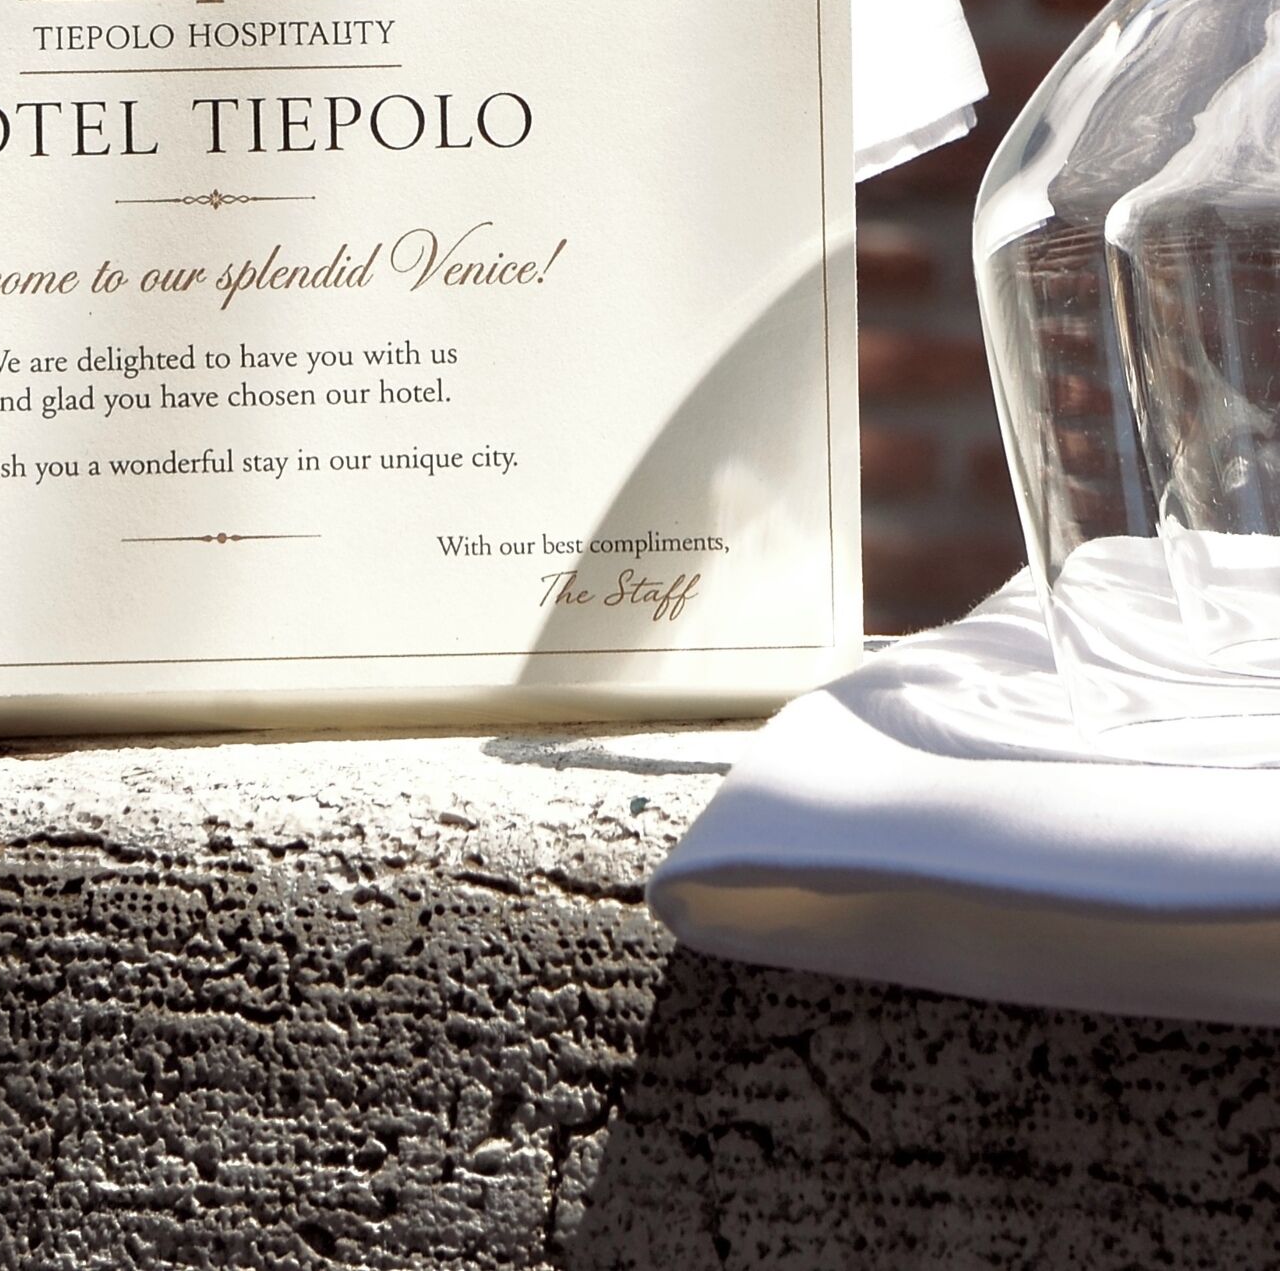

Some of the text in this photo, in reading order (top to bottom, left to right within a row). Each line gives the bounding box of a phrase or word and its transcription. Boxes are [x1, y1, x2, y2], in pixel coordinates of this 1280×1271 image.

[32, 19, 396, 51] TIEPOLO HOSPITALITY
[191, 91, 533, 155] TIEPOLO
[90, 259, 129, 294] to
[139, 267, 208, 293] our
[215, 243, 379, 310] splendid
[390, 220, 568, 292] Venice!
[29, 356, 69, 374] are
[76, 343, 197, 380] delighted
[204, 350, 232, 370] to
[239, 342, 298, 369] have
[305, 350, 354, 376] you
[362, 339, 422, 366] with
[430, 347, 458, 365] us
[41, 383, 96, 420] glad
[103, 392, 152, 419] you
[159, 382, 220, 409] have
[227, 380, 316, 408] chosen
[325, 388, 371, 406] our
[379, 377, 451, 404] hotel.
[34, 460, 80, 486] you
[87, 460, 102, 477] a
[107, 447, 234, 476] wonderful
[242, 454, 289, 480] stay
[297, 448, 321, 472] in
[329, 454, 372, 471] our
[379, 445, 464, 477] unique
[471, 444, 519, 476] city.
[436, 530, 730, 560] With our best compliments,
[539, 567, 702, 622] The Staff
